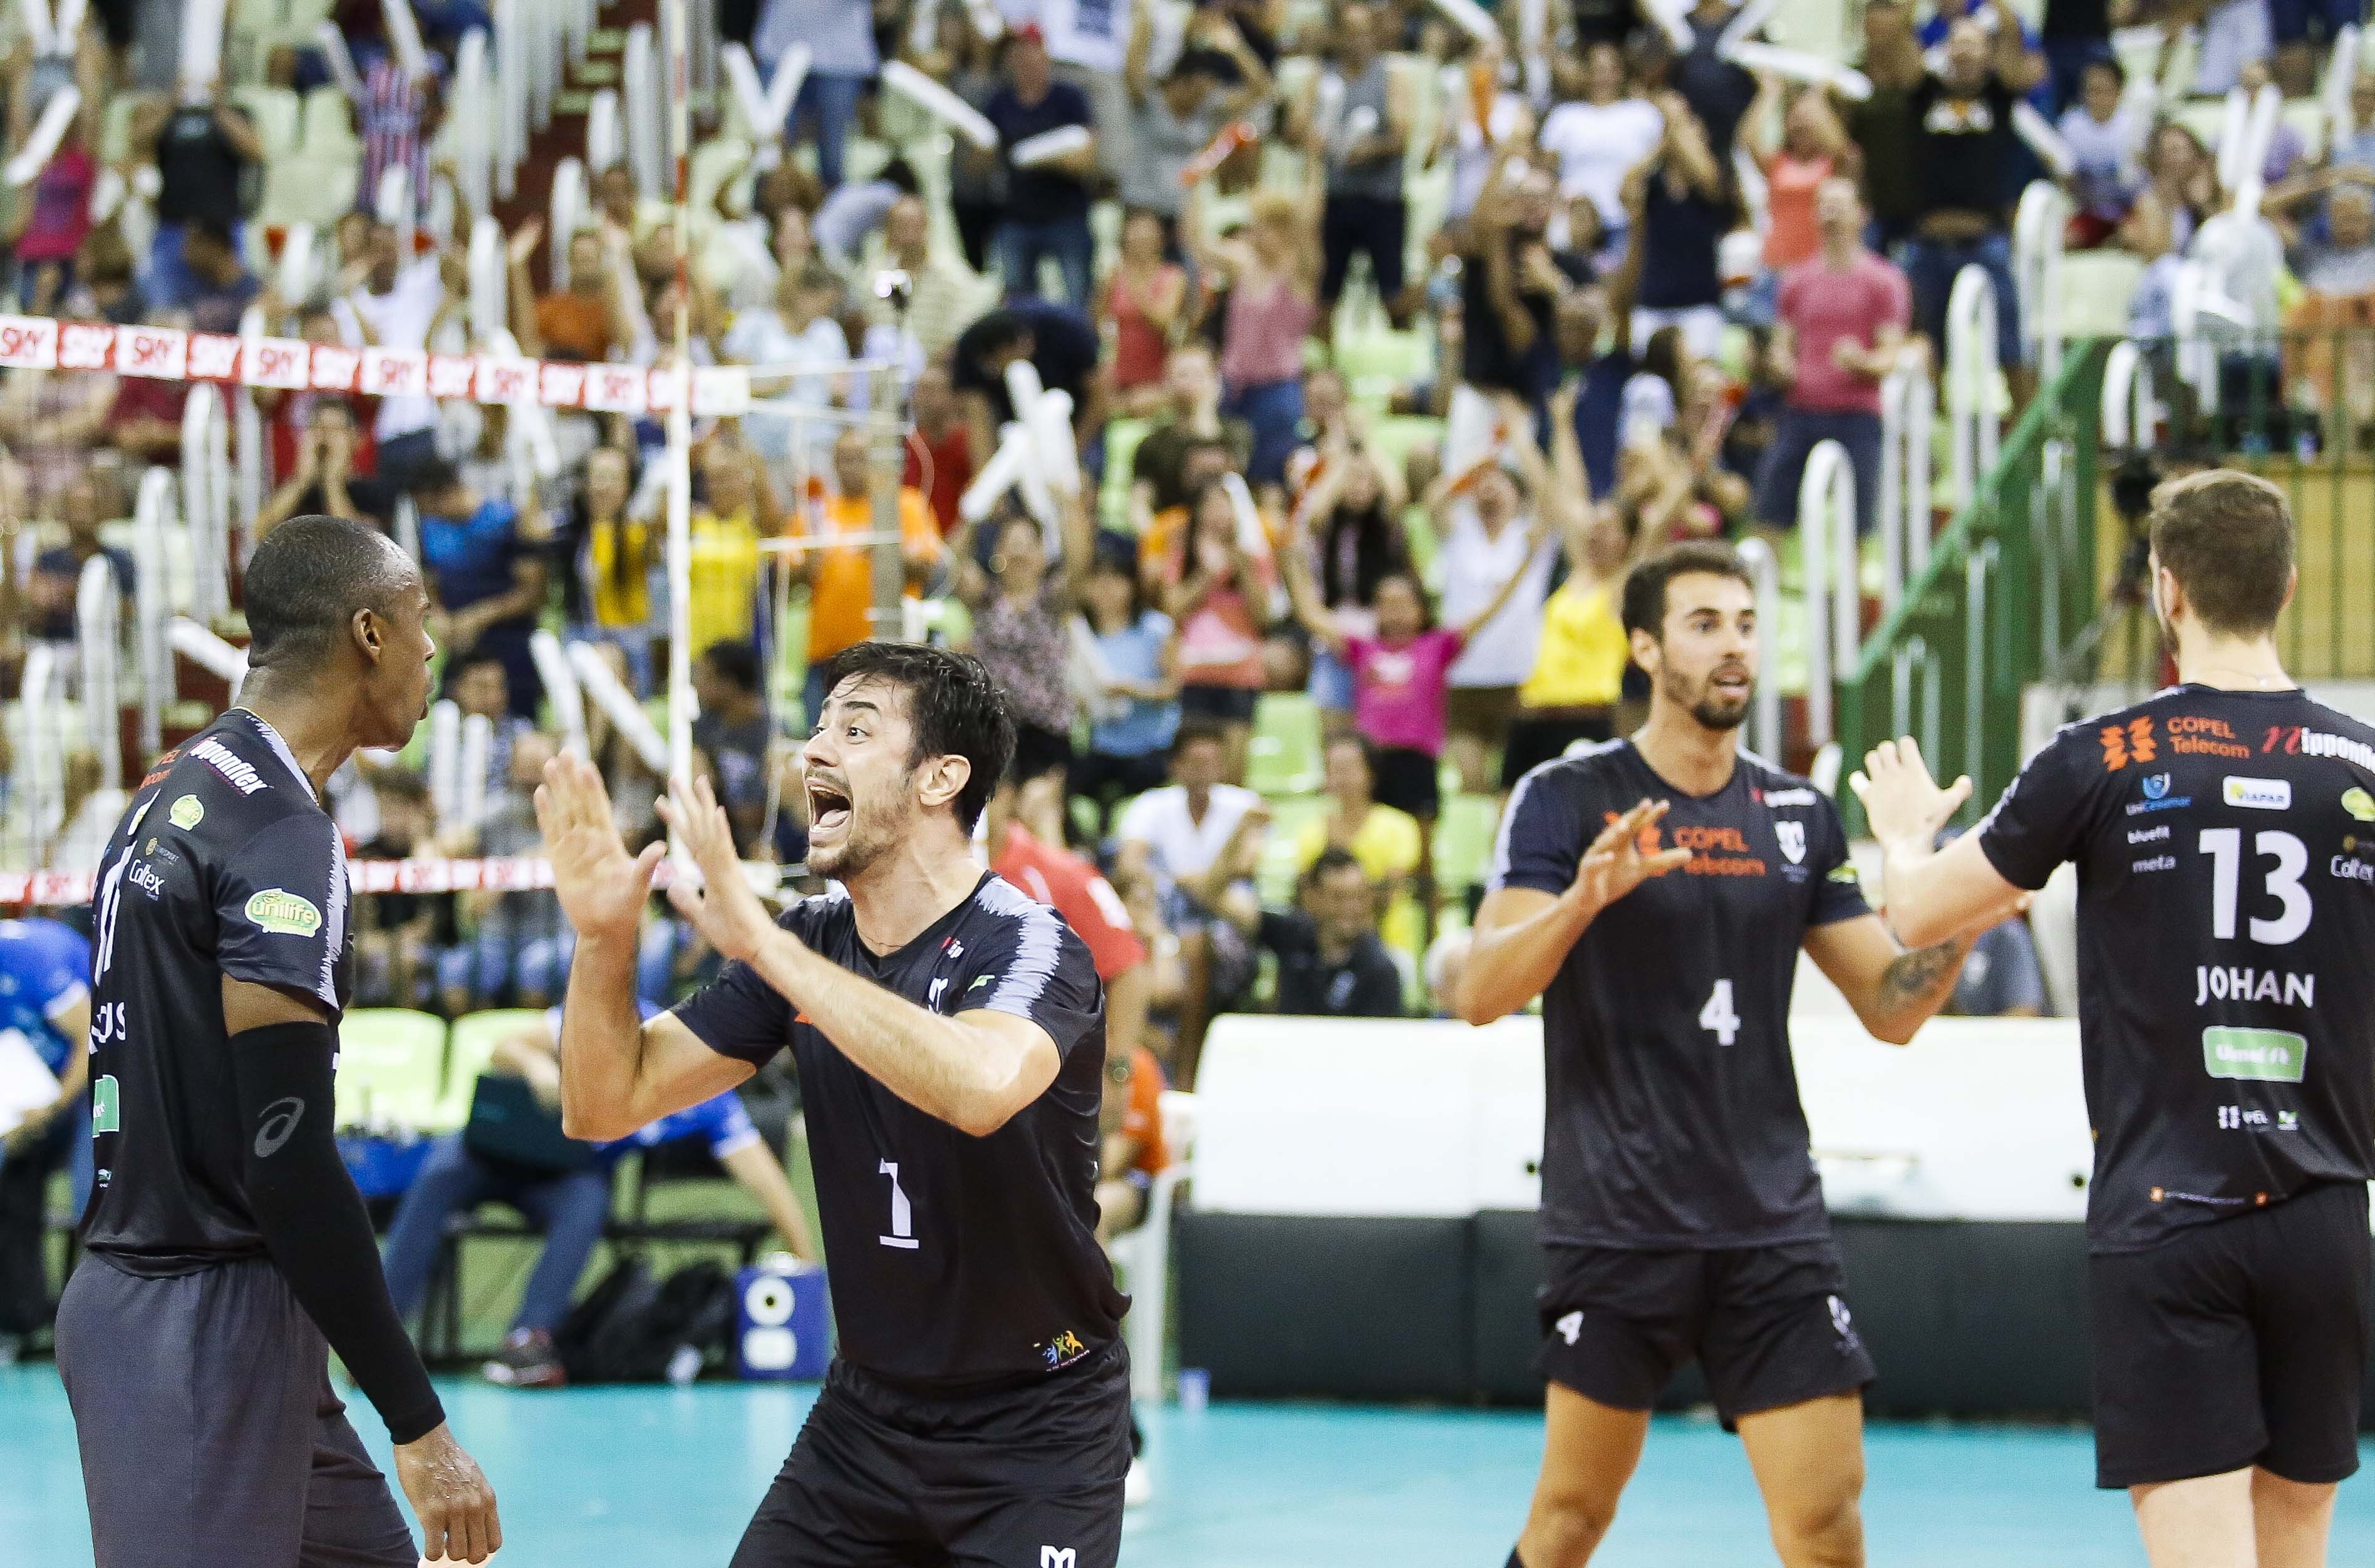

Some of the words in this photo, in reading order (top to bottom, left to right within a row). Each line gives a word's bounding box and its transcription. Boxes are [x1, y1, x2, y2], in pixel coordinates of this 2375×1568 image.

[1, 327, 44, 357] SKY
[133, 336, 175, 366] SKY
[258, 348, 298, 375] SKY
[2167, 716, 2235, 740] COPEL
[2169, 735, 2251, 759] Telecom
[1673, 825, 1750, 852] COPEL
[2199, 827, 2313, 945] 13
[252, 900, 316, 924] unilife
[2194, 965, 2315, 1008] JOHAN
[1698, 977, 1741, 1046] 4
[879, 1157, 919, 1249] 1
